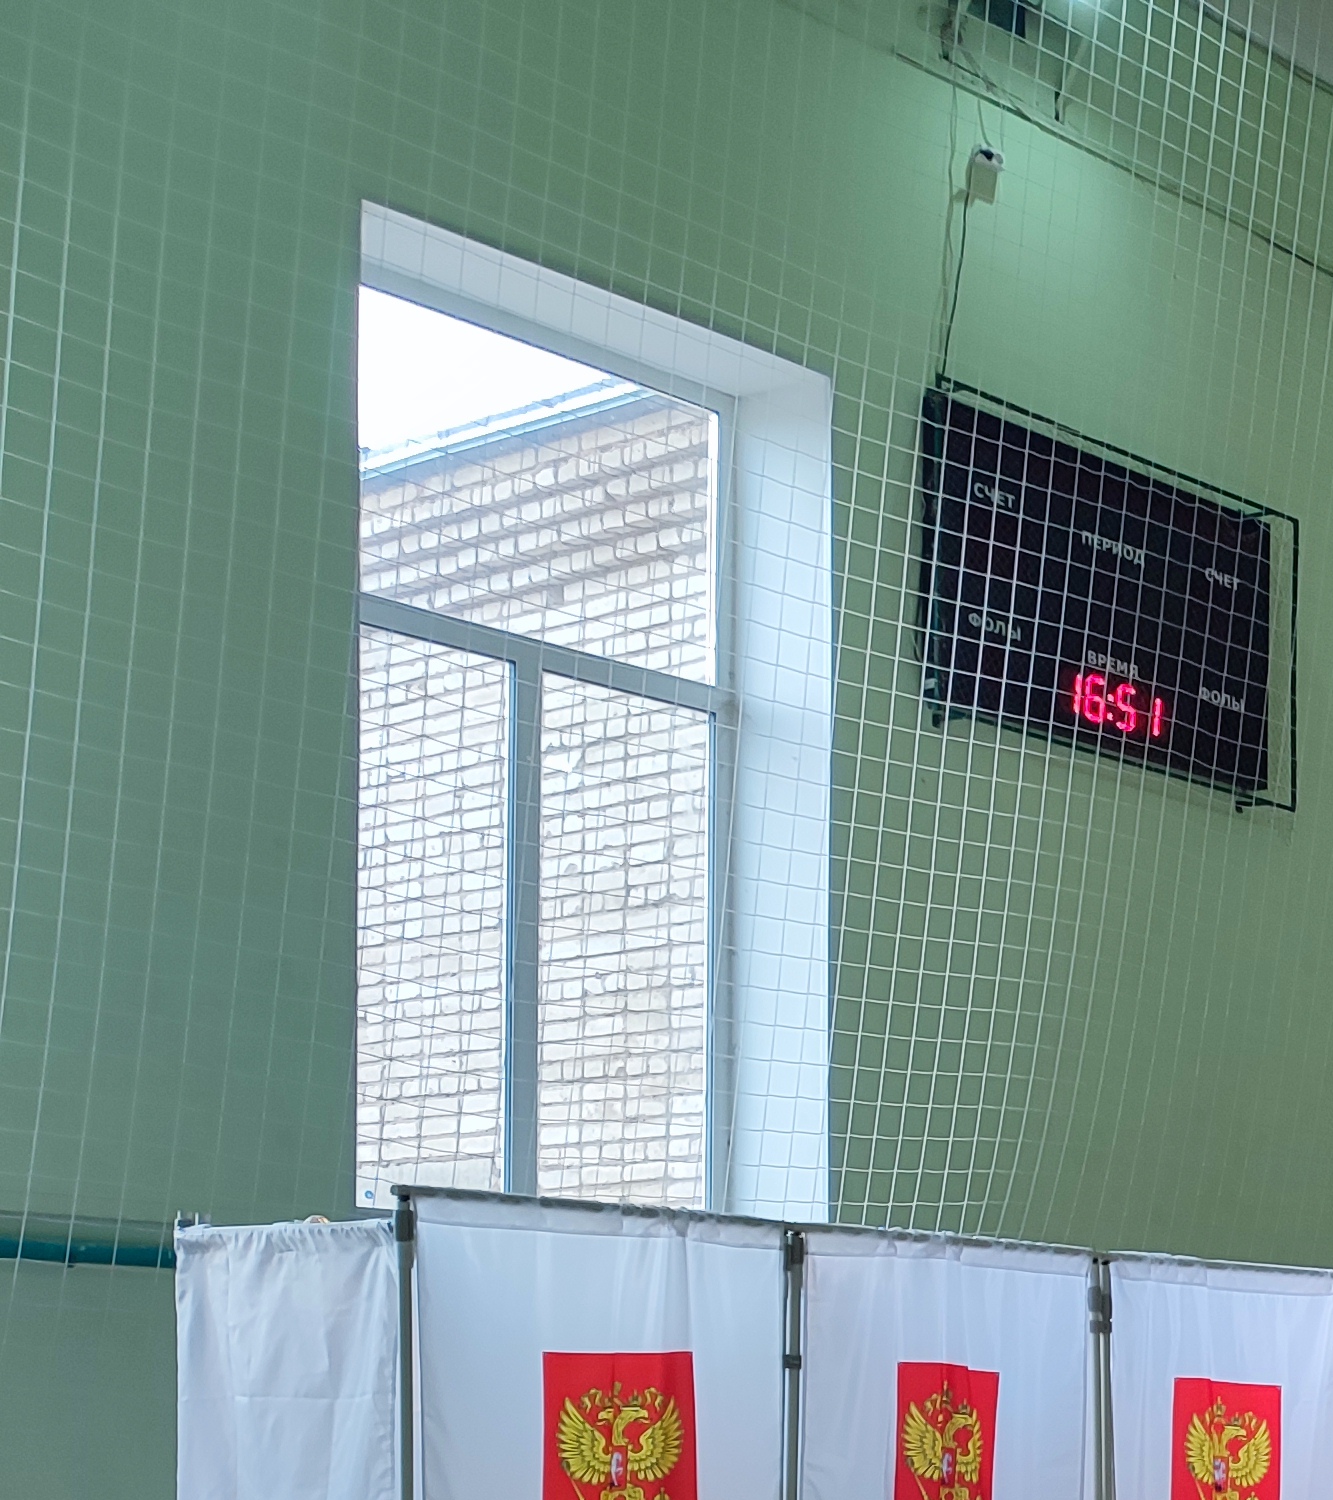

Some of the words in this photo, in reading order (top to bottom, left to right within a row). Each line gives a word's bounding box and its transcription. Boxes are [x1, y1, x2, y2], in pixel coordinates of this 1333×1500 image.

[973, 482, 1016, 509] СЧЕТ
[1081, 530, 1146, 568] ПЕРИОД
[1204, 567, 1240, 591] СЧЕТ
[967, 612, 1022, 642] ФОЛЫ
[1087, 650, 1140, 679] ВРЕМЯ
[1073, 673, 1163, 737] 16:51
[1200, 686, 1246, 714] ФОЛЫ
